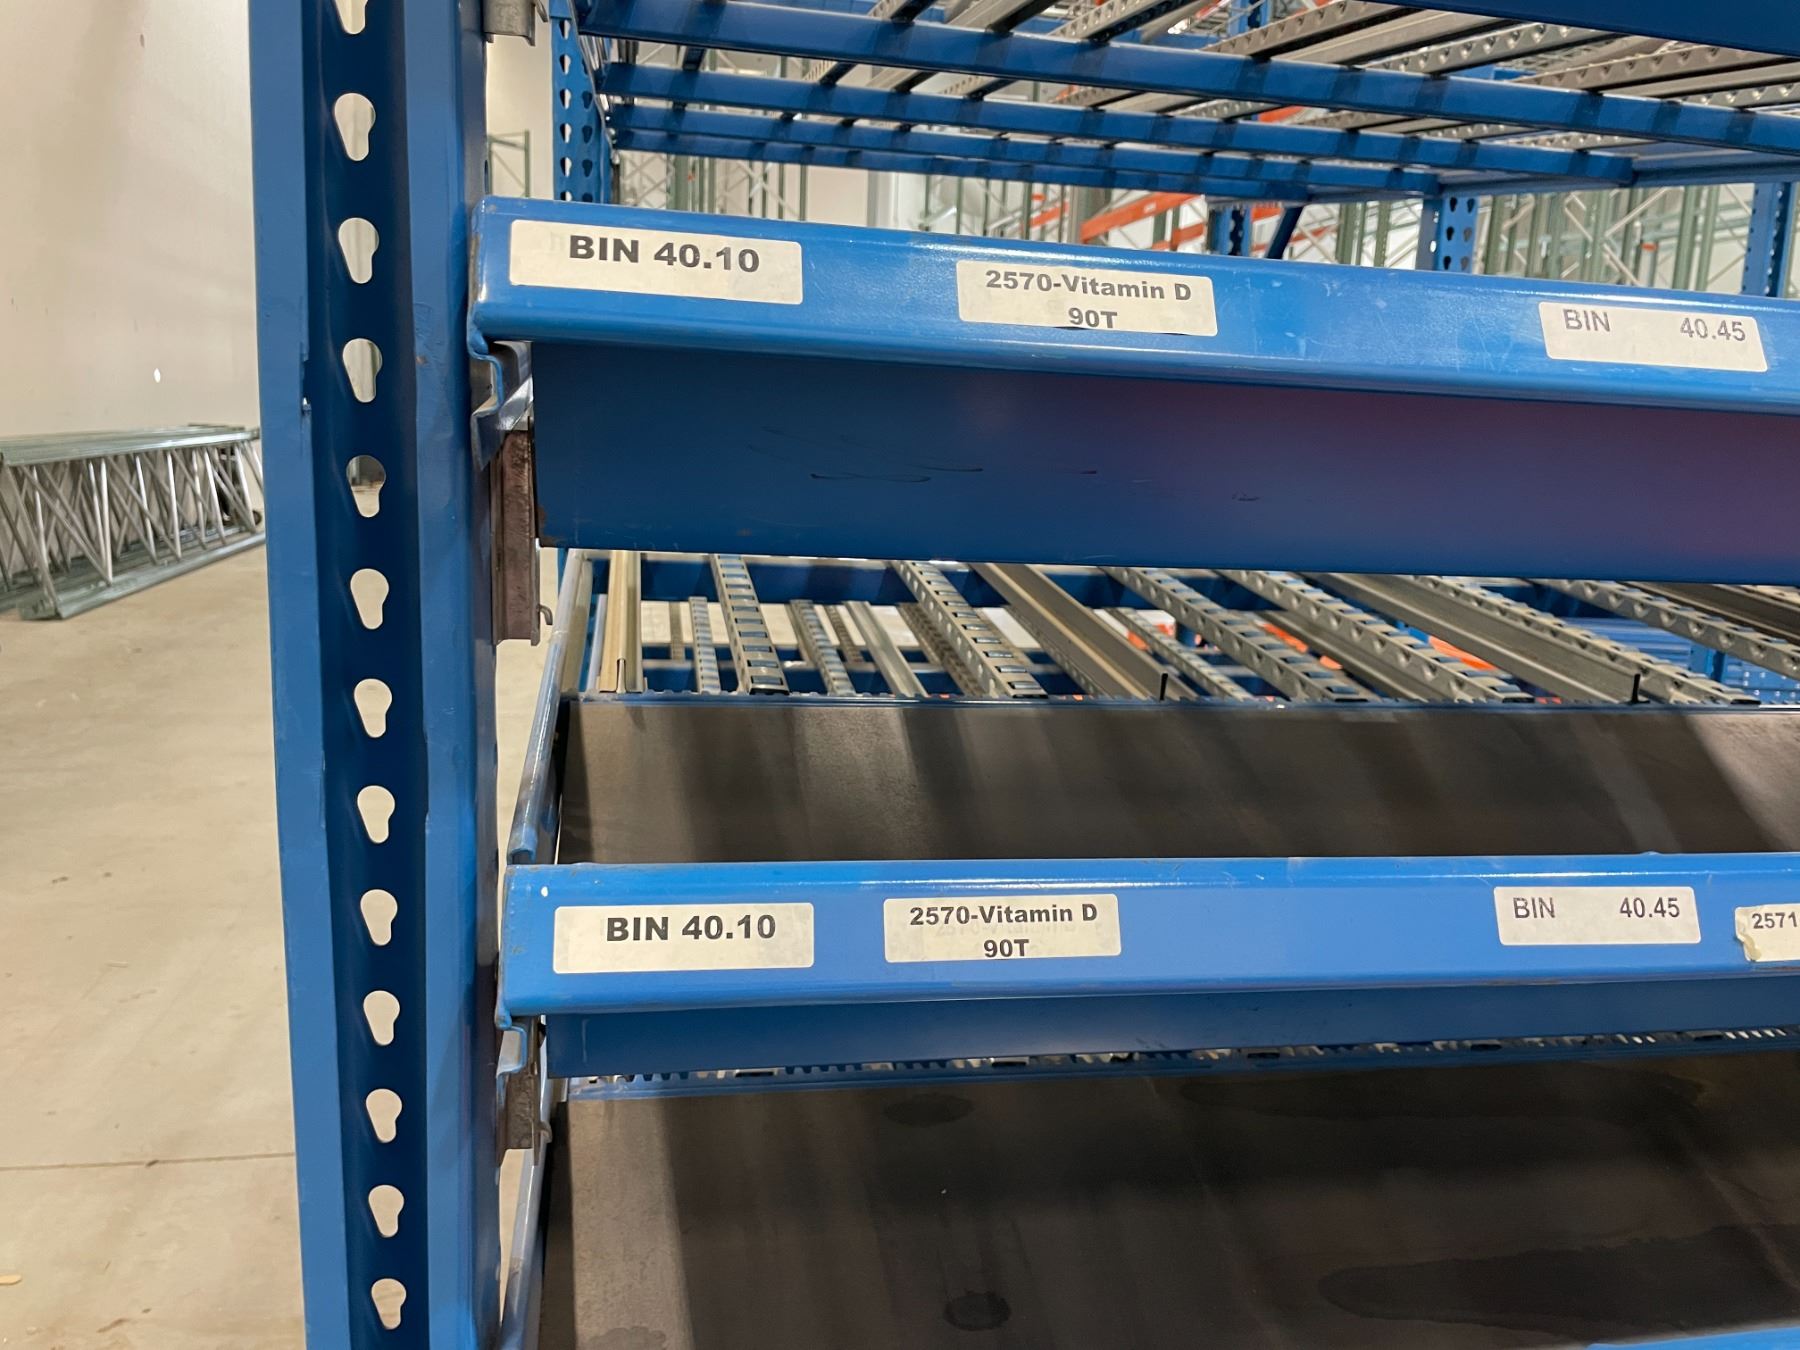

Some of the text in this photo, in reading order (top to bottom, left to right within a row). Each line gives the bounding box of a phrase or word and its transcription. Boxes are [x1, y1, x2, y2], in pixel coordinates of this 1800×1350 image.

[569, 235, 760, 273] BIN 40.10
[985, 269, 1192, 301] 2570-Vitamin D
[1067, 306, 1118, 329] 90T
[1562, 308, 1746, 342] BIN 40.45
[909, 903, 1098, 926] 2570-Vitamin D
[1512, 896, 1681, 919] BIN 40.45
[606, 914, 776, 942] BIN 40.10
[1751, 911, 1798, 930] 2571
[983, 938, 1030, 958] 90T
